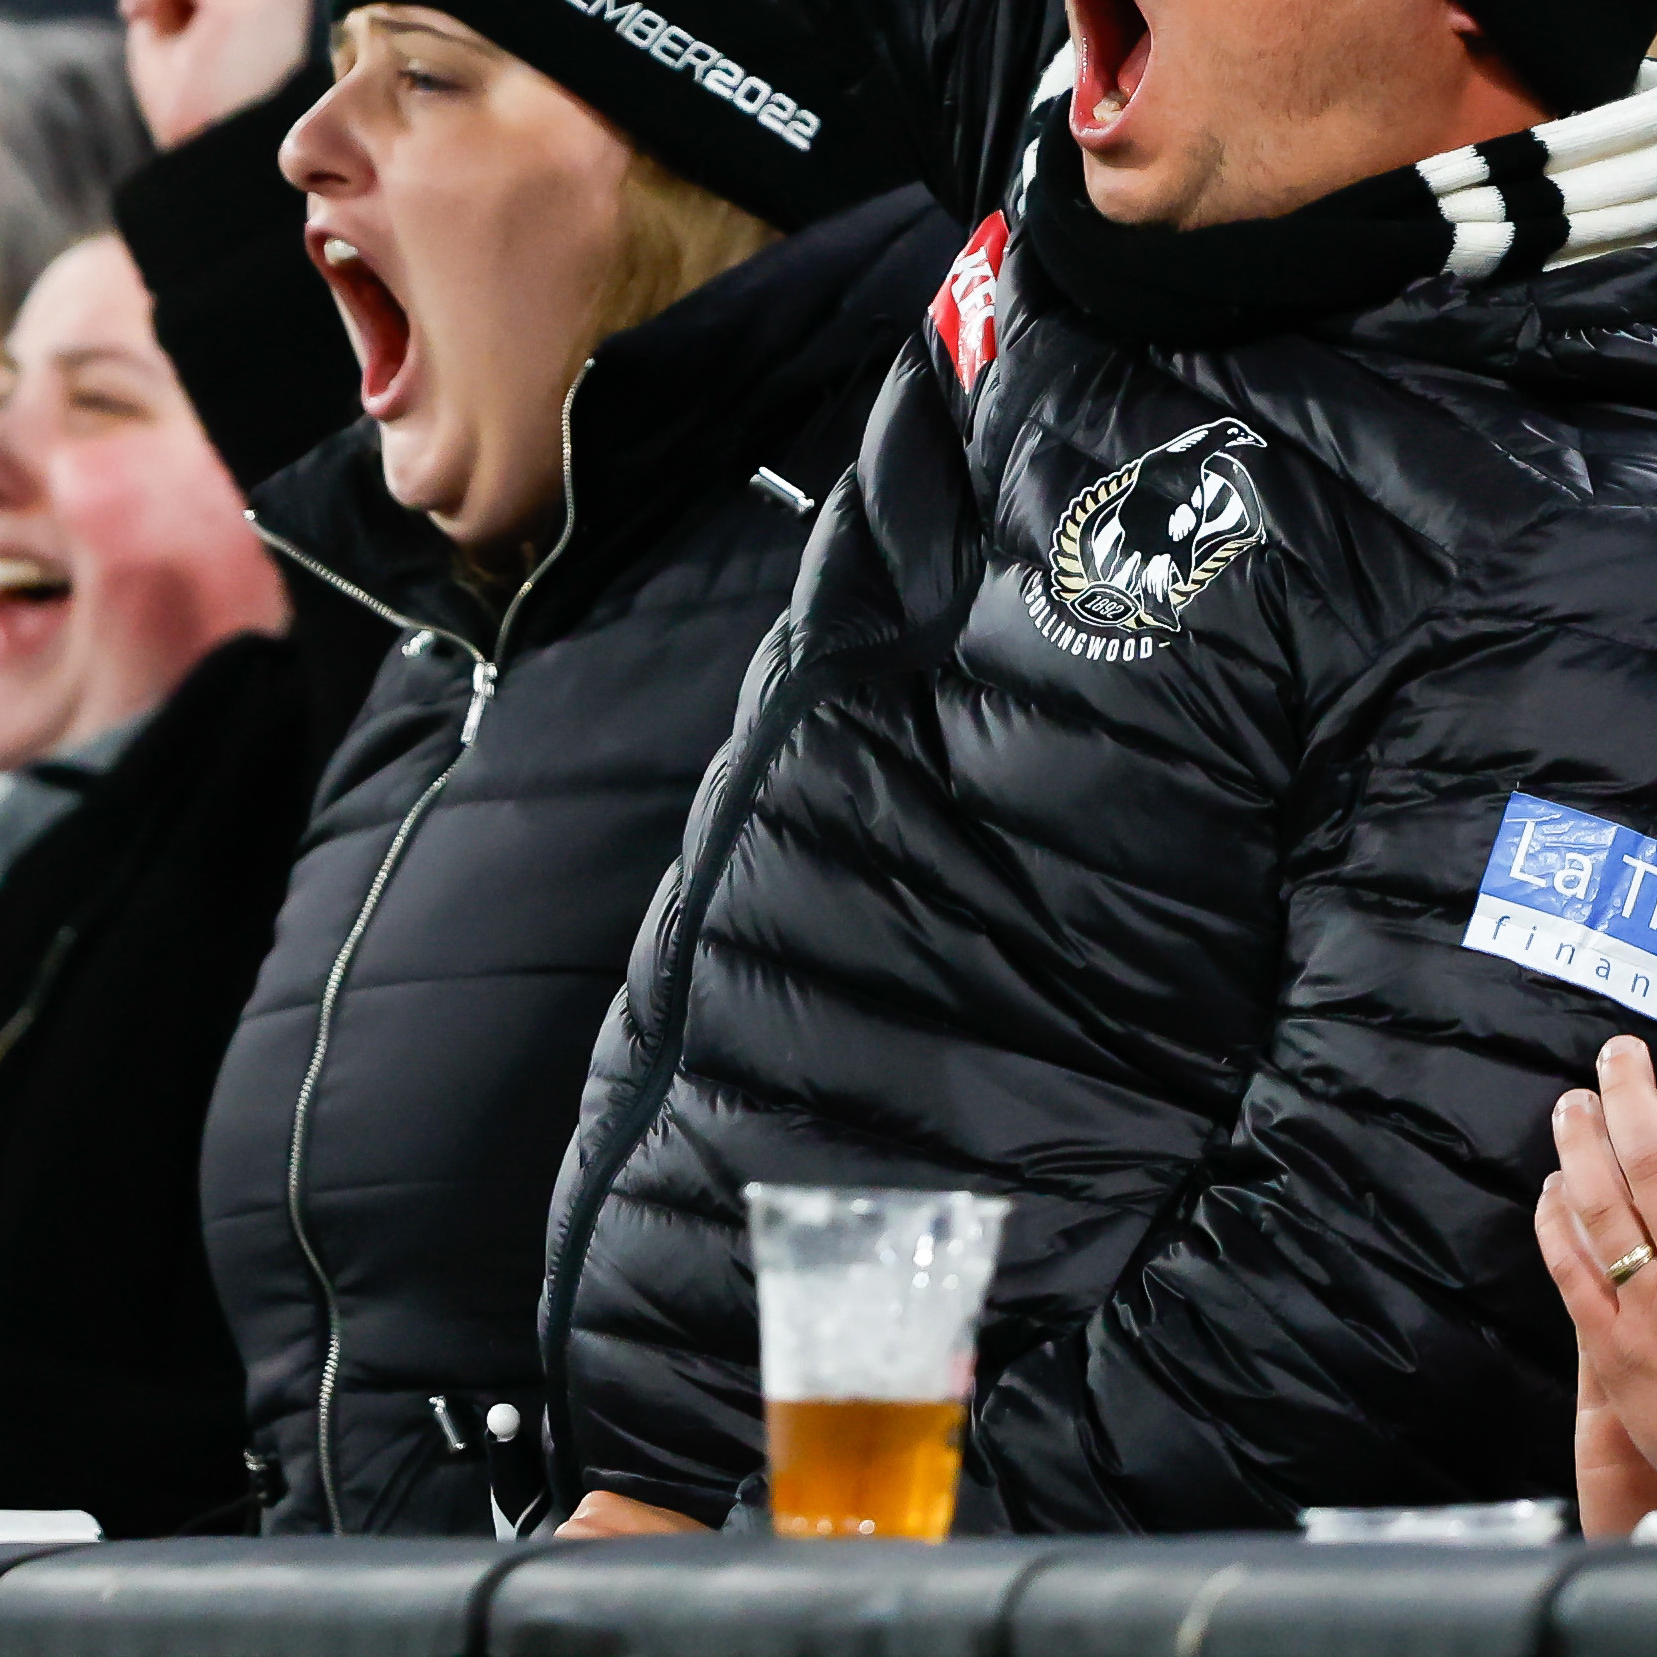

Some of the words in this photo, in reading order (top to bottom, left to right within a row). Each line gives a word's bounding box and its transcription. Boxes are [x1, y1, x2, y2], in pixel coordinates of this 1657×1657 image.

[1024, 584, 1153, 662] COLLINGWOOD
[1085, 595, 1125, 619] 1892
[1506, 817, 1592, 902] La
